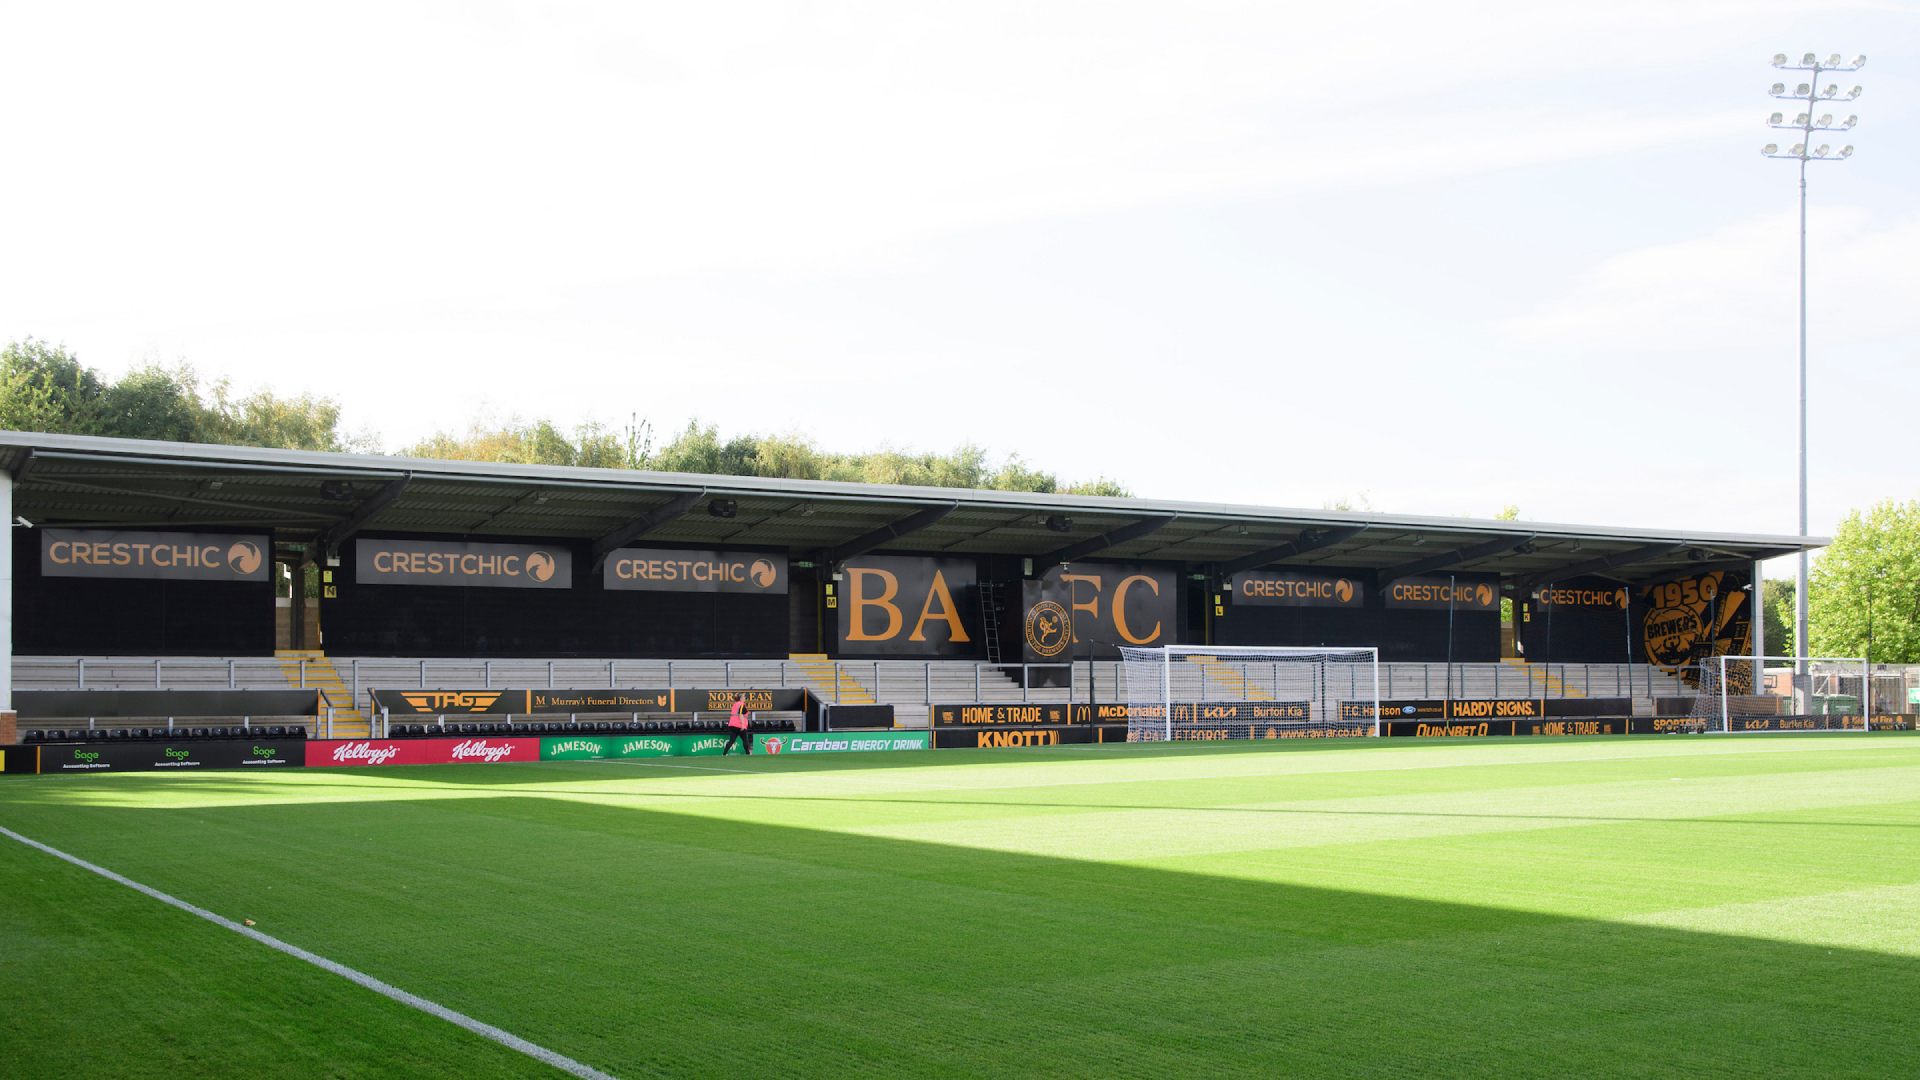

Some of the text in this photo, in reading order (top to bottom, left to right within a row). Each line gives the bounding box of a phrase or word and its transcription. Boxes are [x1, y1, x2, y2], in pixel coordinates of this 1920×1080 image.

[50, 541, 221, 568] CRESTCHIC
[374, 551, 520, 576] CRESTCHIC
[616, 559, 745, 582] CRESTCHIC
[1243, 580, 1332, 598] CRESTCHIC
[1393, 585, 1473, 602] CRESTCHIC
[1653, 574, 1718, 609] 1950
[1540, 589, 1612, 606] CRESTCHIC
[1646, 614, 1697, 639] BREWERS
[551, 695, 654, 707] Murray's Funeral Directors
[708, 692, 772, 702] NORLEAN
[962, 707, 994, 723] HOME
[997, 707, 1006, 723] &
[1007, 707, 1042, 722] TRADE
[1098, 706, 1166, 718] McDonald's
[1254, 705, 1303, 717] Burton Kia
[1344, 706, 1401, 717] T.C. Harison
[1453, 701, 1535, 717] HARDY SIGNS.
[1416, 723, 1477, 737] QUINNBET
[1542, 721, 1565, 735] HOME
[1567, 721, 1575, 735] &
[1574, 721, 1599, 735] TRADE
[1803, 718, 1815, 729] Kia
[978, 730, 1047, 748] KNOTT
[1144, 729, 1228, 742] PALETFORCE
[452, 739, 512, 762] Kellogg's
[550, 741, 601, 755] JAMESON
[622, 739, 671, 754] JAMESON
[790, 737, 924, 751] Carabao ENERGY DRINK
[74, 749, 99, 763] Sage
[165, 747, 189, 761] Sage
[253, 745, 276, 759] Sage
[333, 741, 397, 765] Kellogg's
